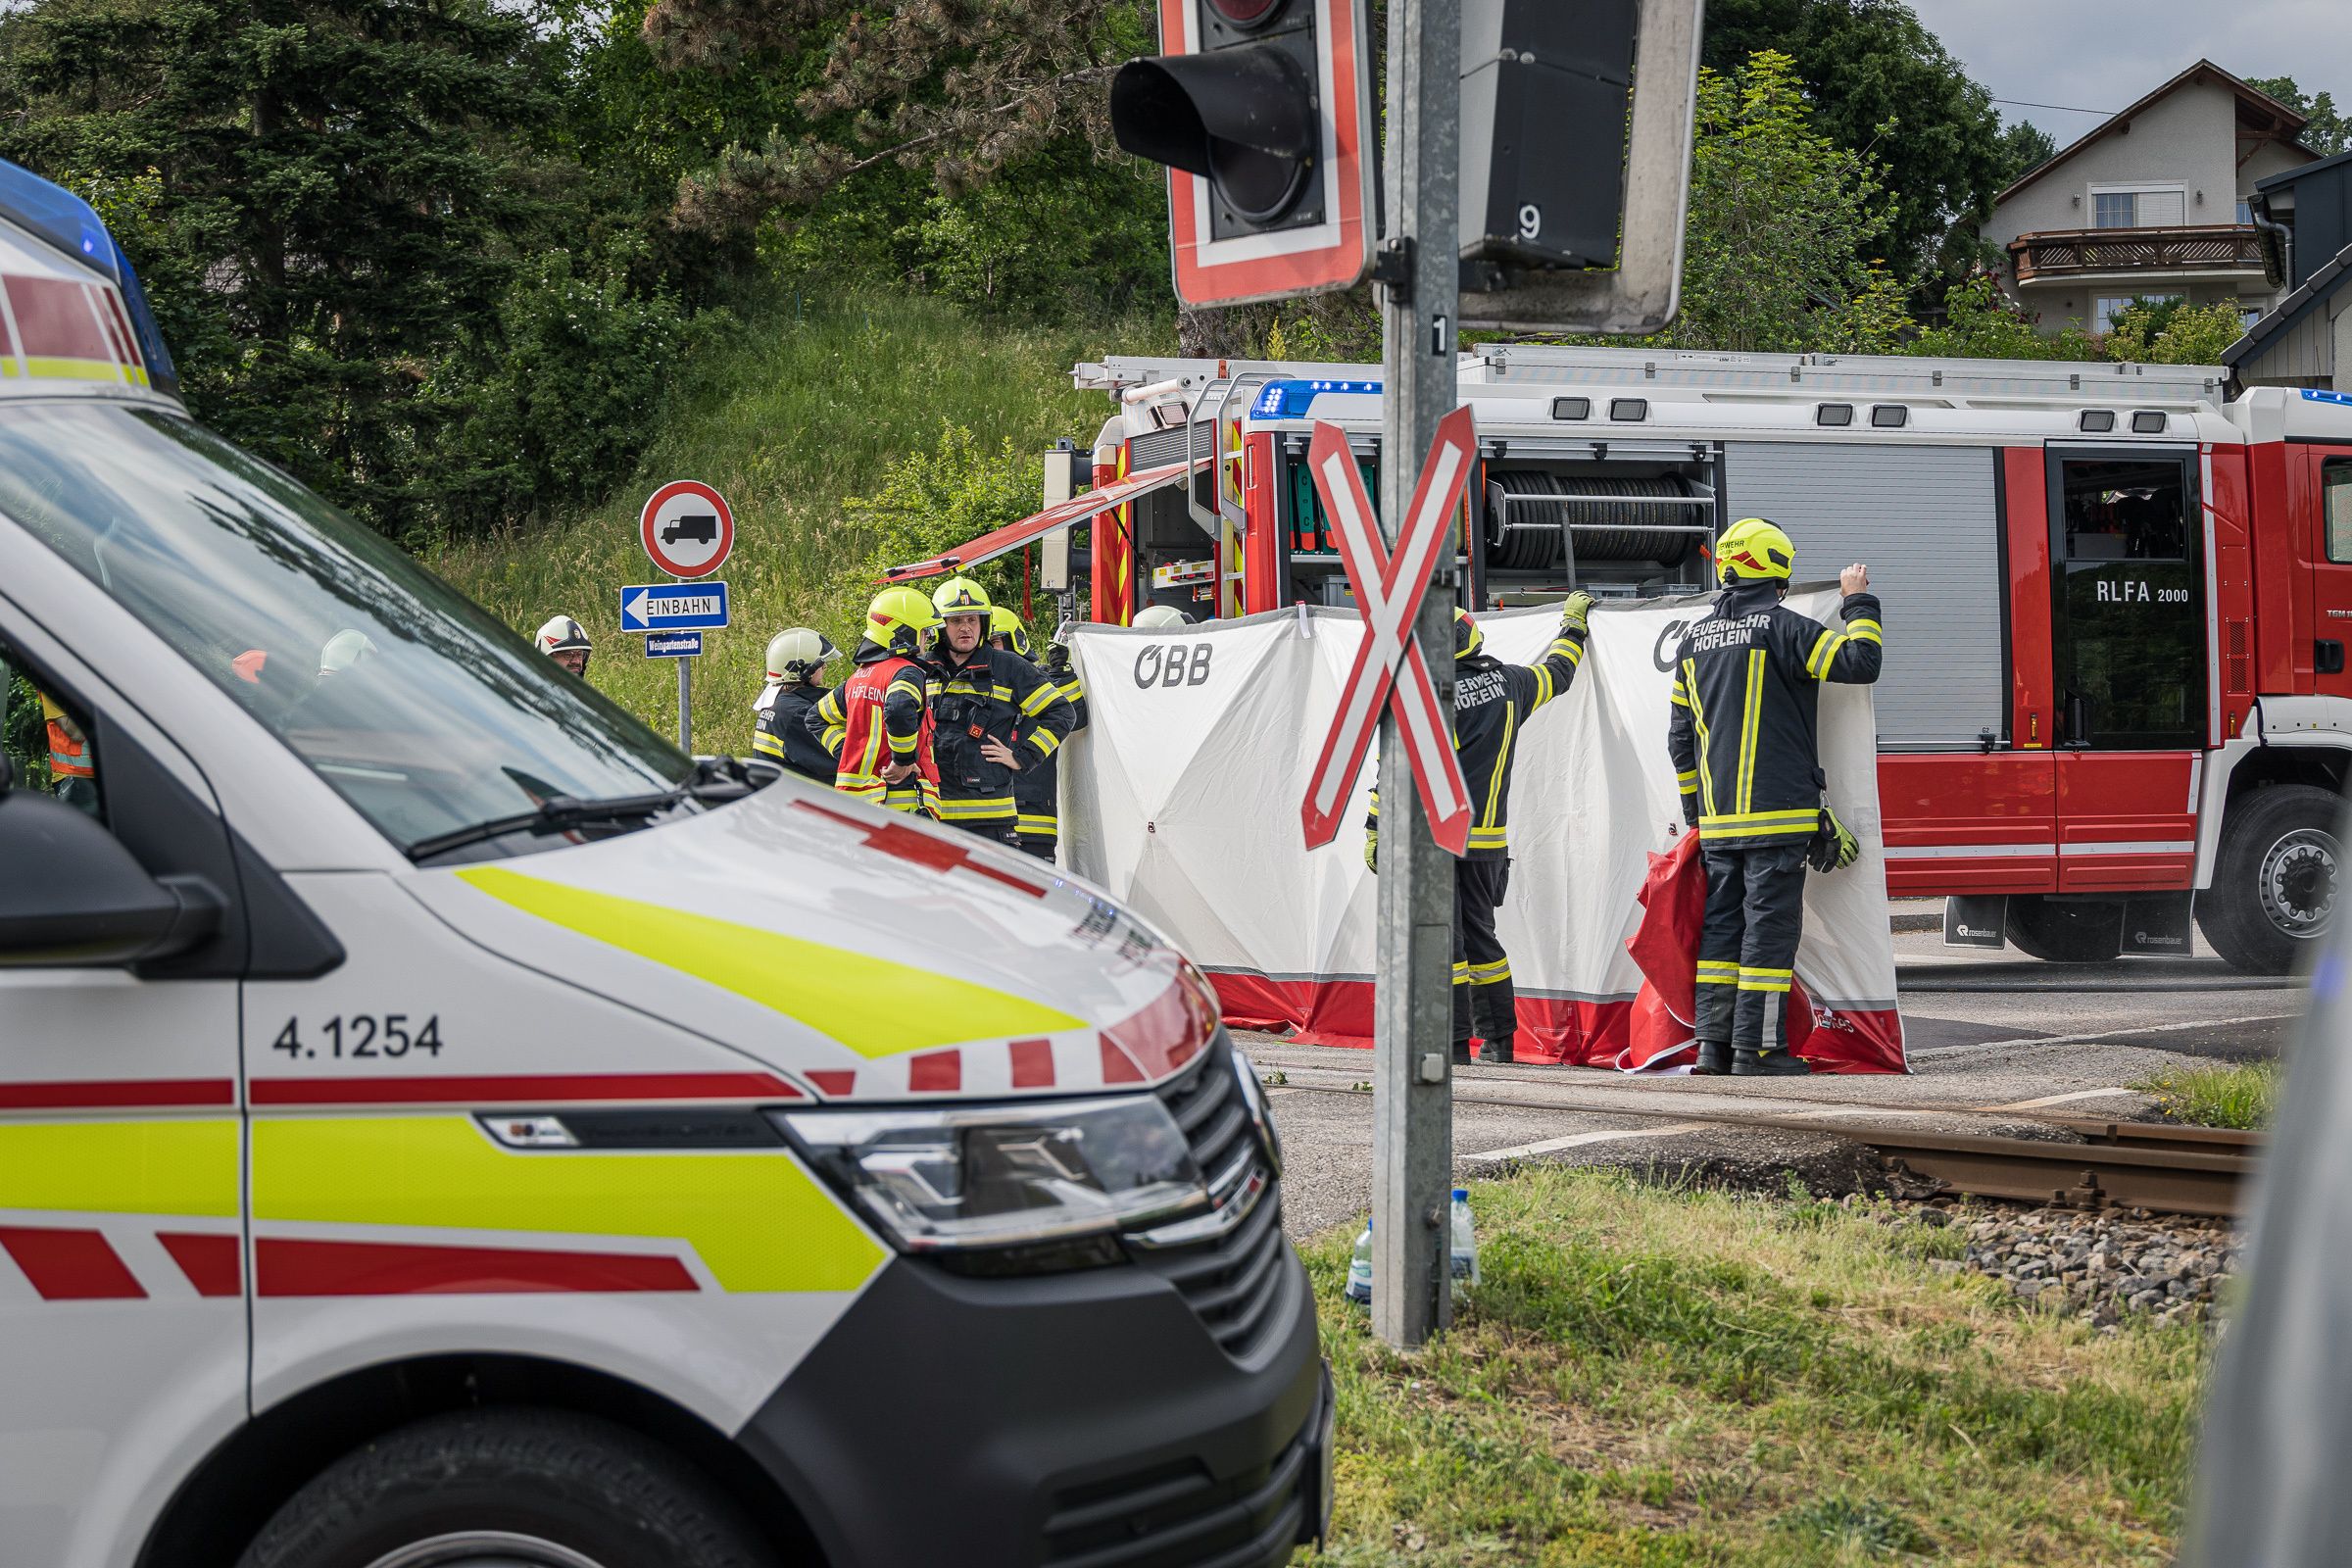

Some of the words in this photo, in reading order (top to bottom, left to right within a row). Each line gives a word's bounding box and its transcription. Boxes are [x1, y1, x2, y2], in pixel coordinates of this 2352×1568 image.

[1519, 204, 1541, 239] 9
[1433, 317, 1446, 352] 1
[2096, 580, 2150, 602] RLFA
[2157, 589, 2188, 602] 2000
[647, 598, 711, 615] EINBAHN
[1686, 614, 1771, 640] FEUERWEHR
[1692, 628, 1752, 654] HÖFLEIN
[1134, 643, 1213, 690] ÖBB
[272, 1014, 444, 1058] 4.1254
